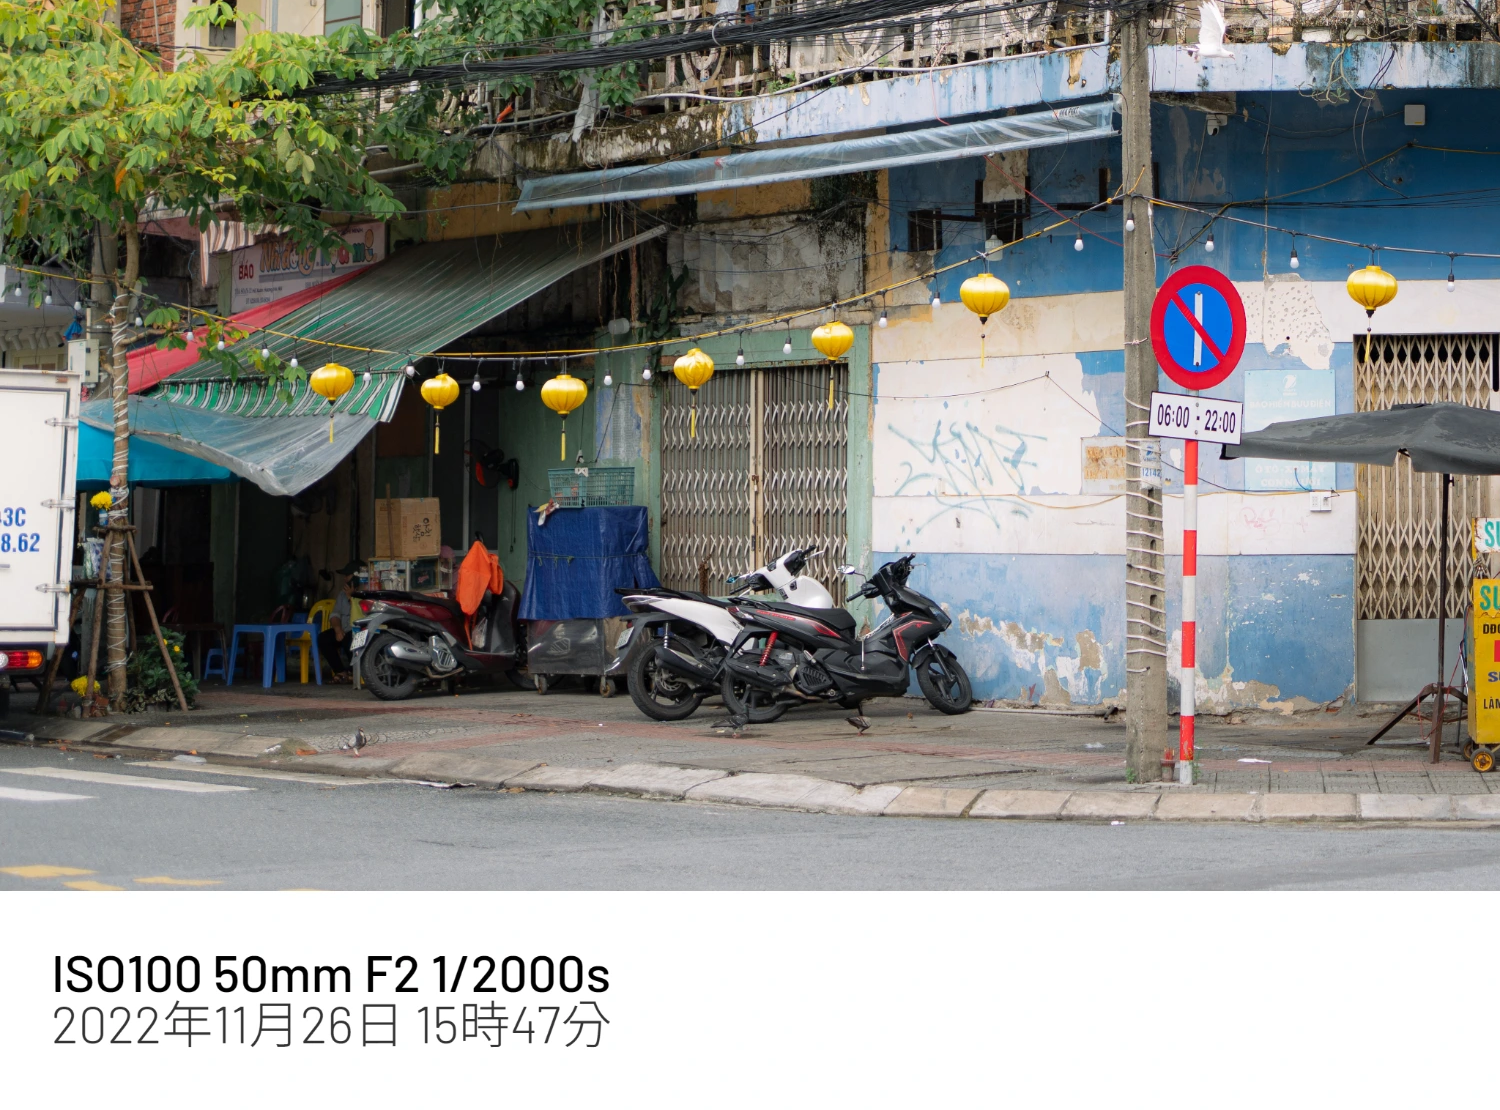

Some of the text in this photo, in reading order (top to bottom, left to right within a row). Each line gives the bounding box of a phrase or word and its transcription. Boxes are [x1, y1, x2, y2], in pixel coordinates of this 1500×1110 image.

[238, 260, 255, 281] BÁO
[1157, 403, 1190, 428] 06:00
[1204, 409, 1236, 434] 22:00
[1142, 468, 1161, 477] 12142
[0, 507, 26, 527] 3C
